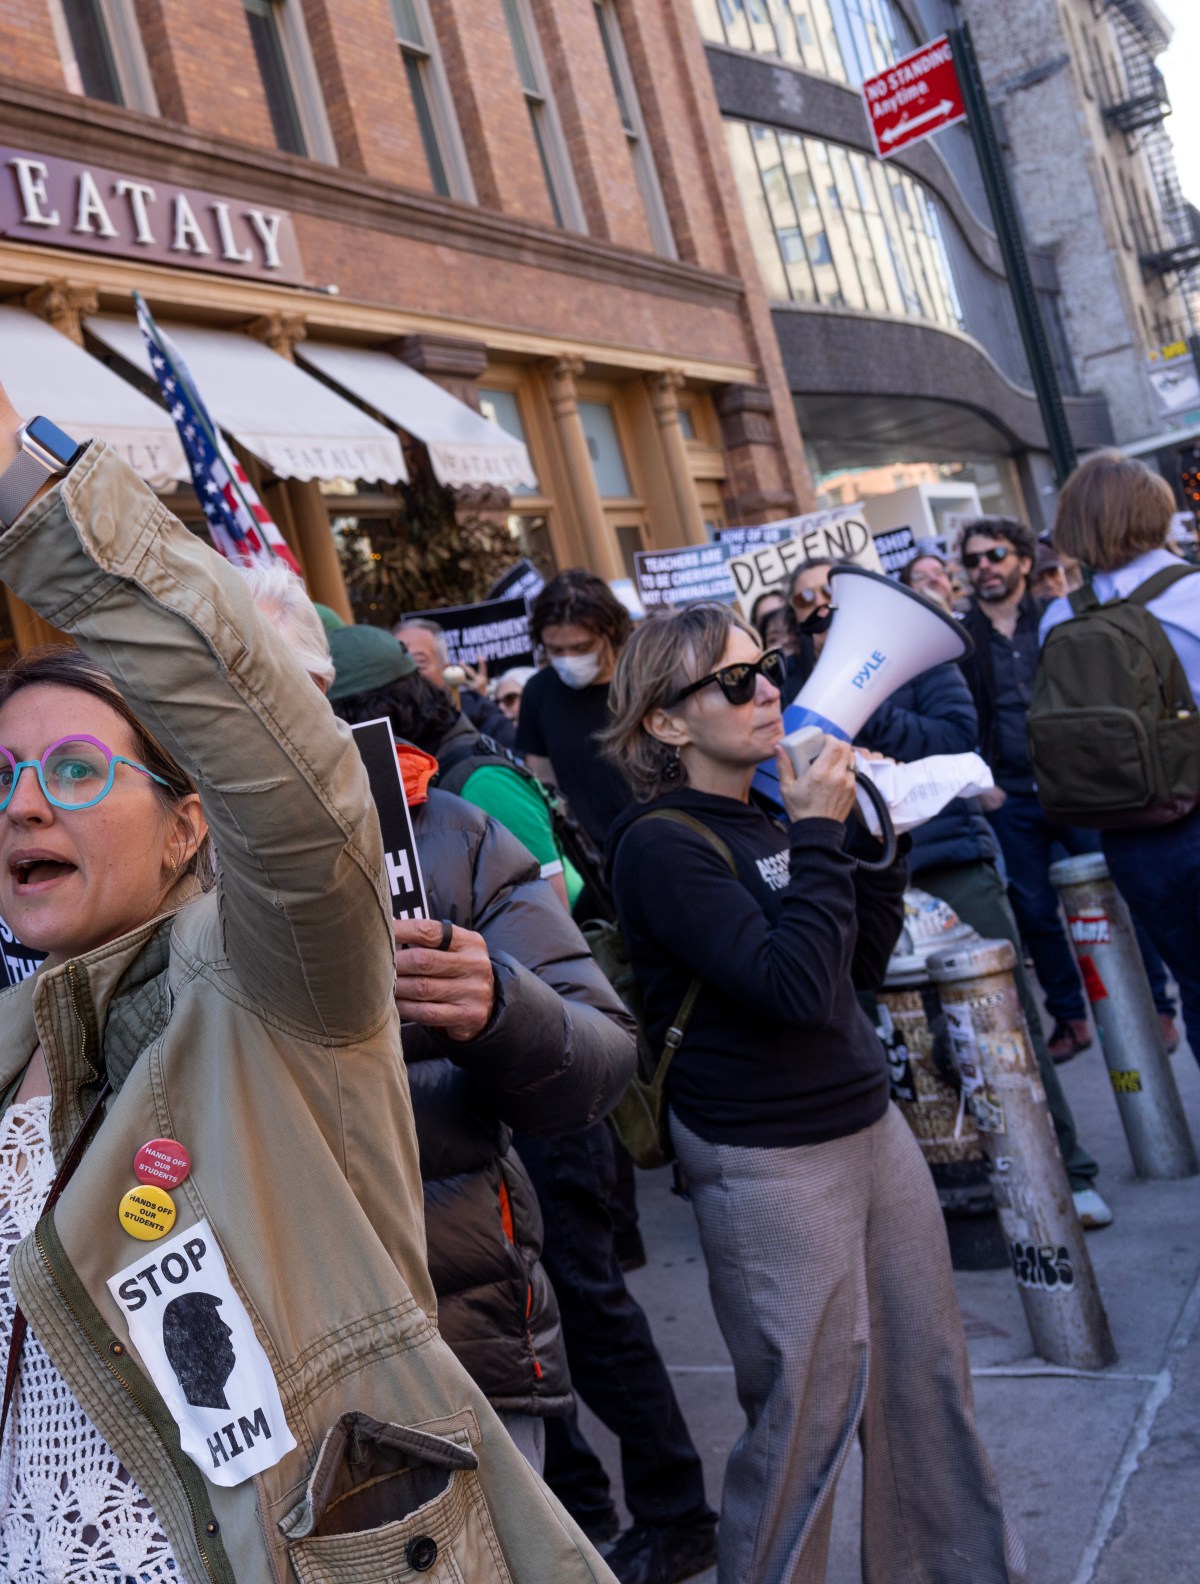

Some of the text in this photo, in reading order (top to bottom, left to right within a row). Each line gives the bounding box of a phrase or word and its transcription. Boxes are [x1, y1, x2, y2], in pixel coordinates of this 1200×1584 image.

[866, 43, 953, 101] NO STANDING
[873, 80, 930, 119] Anytime
[7, 155, 282, 270] EATALY
[731, 520, 869, 595] DEFEND
[145, 1147, 188, 1168] HANDS OFF
[154, 1161, 171, 1171] OUR
[138, 1163, 178, 1183] STUDENTS
[129, 1194, 173, 1216] HANDS OFF
[139, 1208, 157, 1219] OUR
[124, 1211, 165, 1232] STUDENTS
[118, 1237, 207, 1312] STOP
[206, 1406, 272, 1468] HIM
